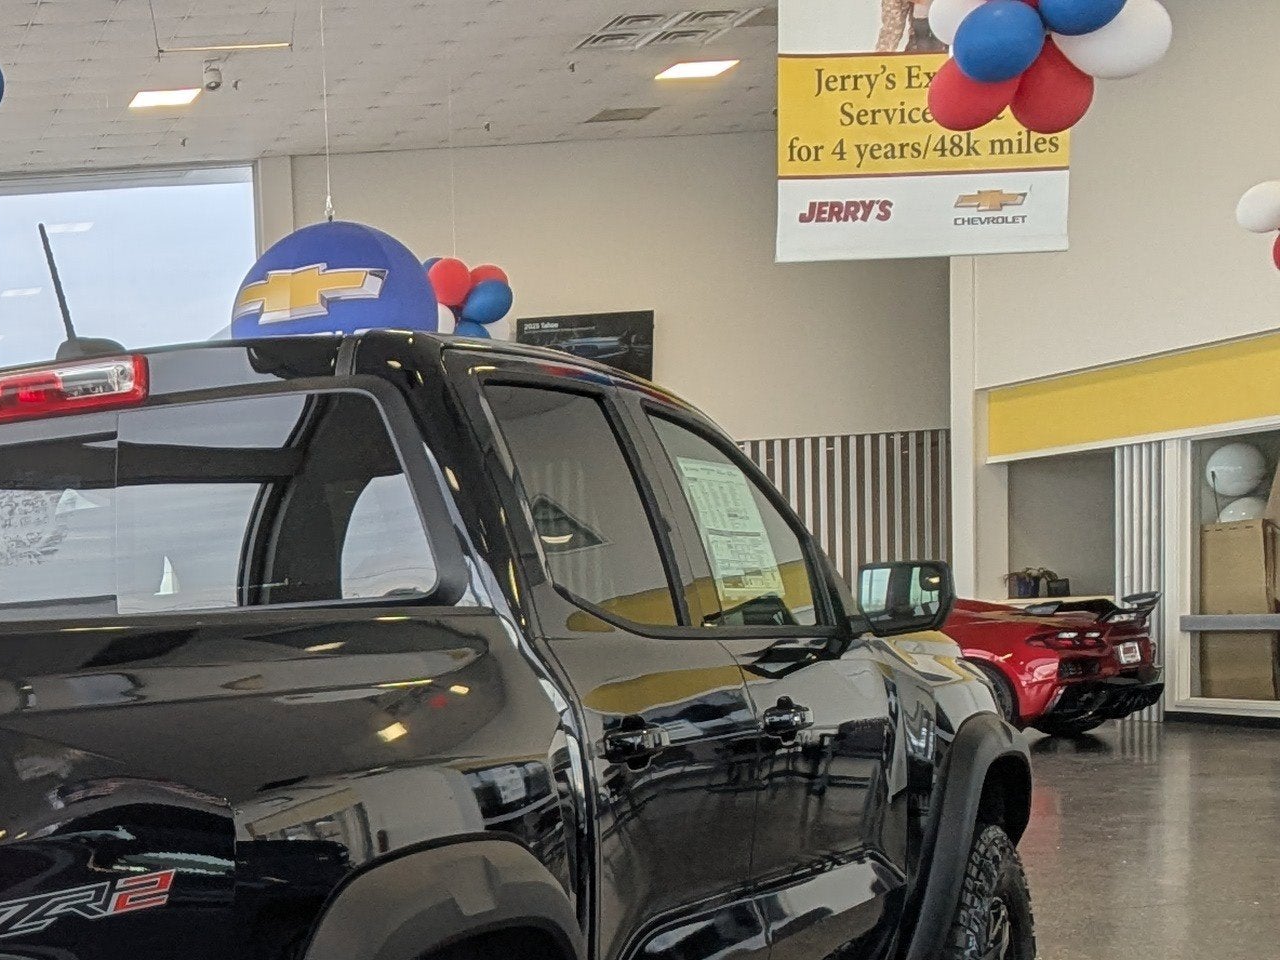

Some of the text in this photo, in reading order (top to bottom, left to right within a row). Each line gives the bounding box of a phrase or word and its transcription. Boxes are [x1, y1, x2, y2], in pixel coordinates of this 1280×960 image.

[814, 64, 897, 98] Jerry's
[839, 101, 933, 126] Service
[787, 131, 1060, 168] for 4 years/48k miles
[798, 200, 894, 224] JERRY'S
[953, 215, 1028, 226] CHEVROLET
